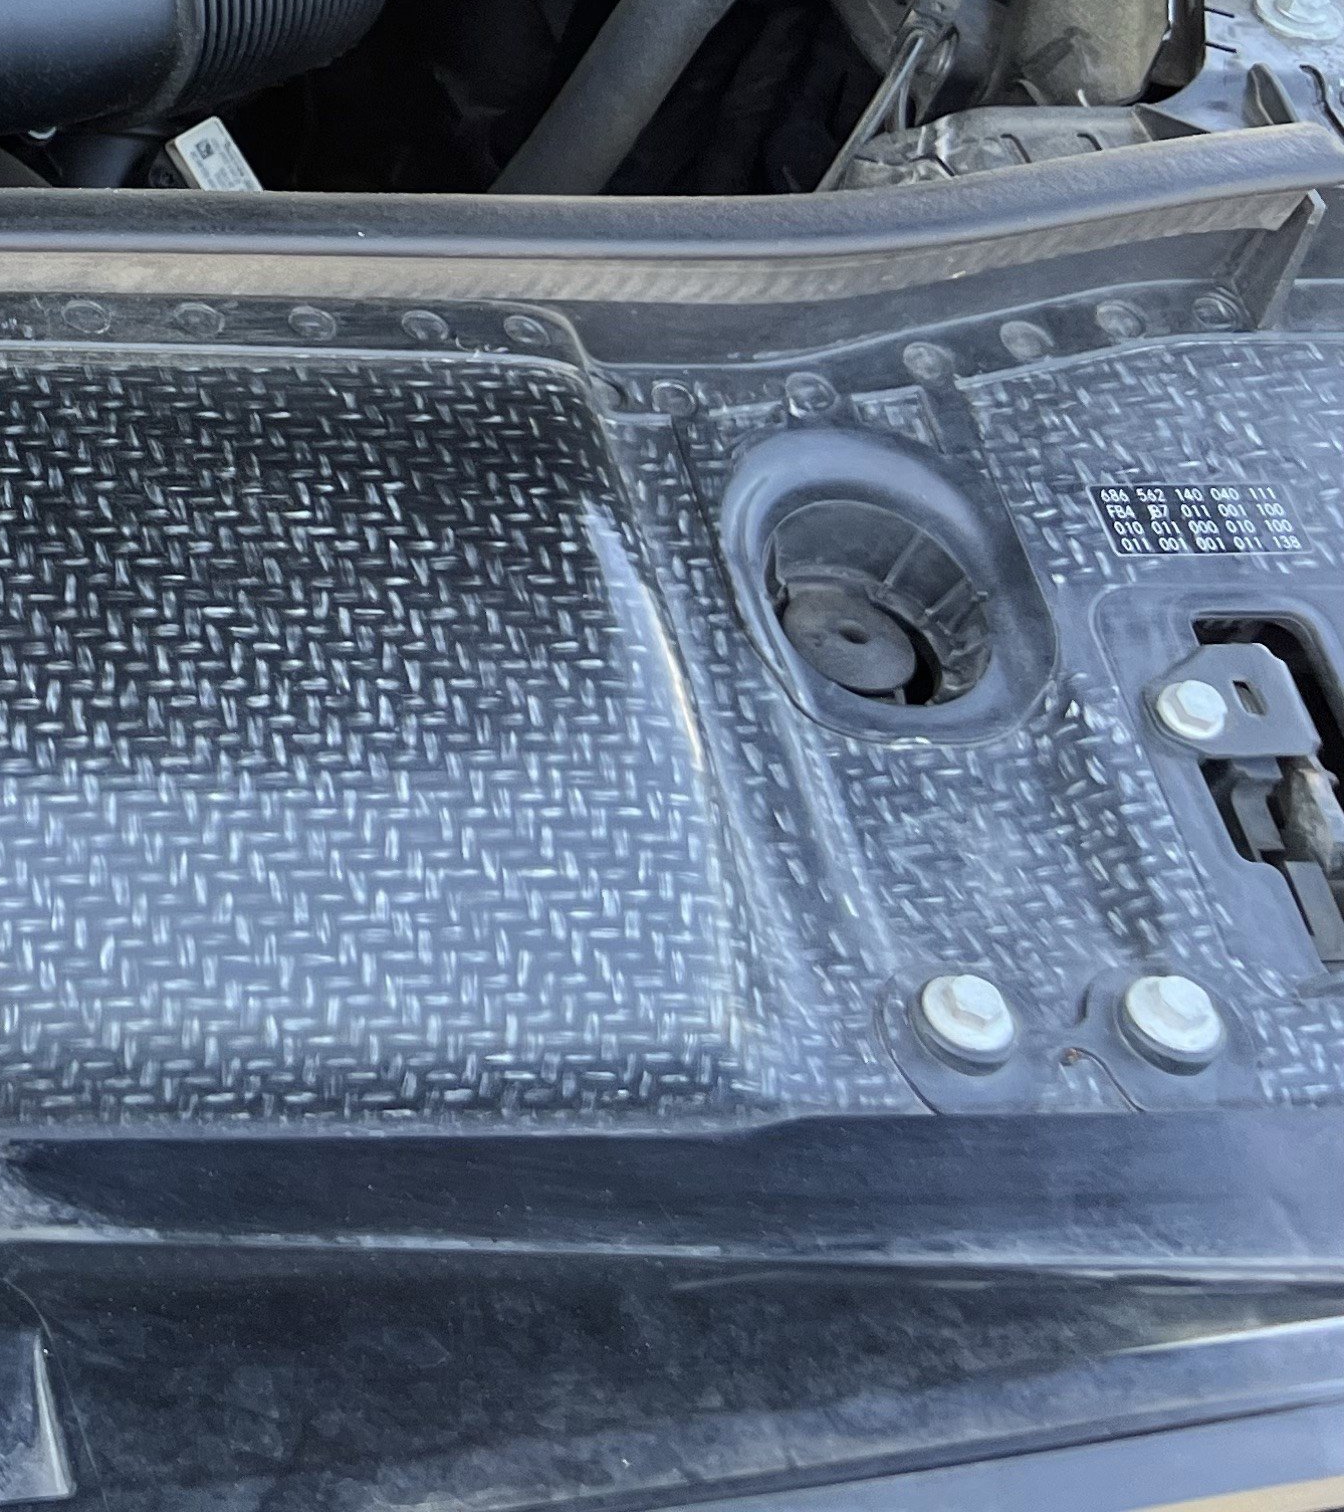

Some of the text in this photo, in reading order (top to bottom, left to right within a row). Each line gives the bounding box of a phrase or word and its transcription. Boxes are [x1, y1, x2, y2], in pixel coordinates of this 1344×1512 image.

[1100, 487, 1277, 503] 686 562 140 040 111
[1181, 504, 1211, 518] 011
[1217, 503, 1247, 517] 001
[1255, 503, 1285, 517] 100
[1113, 519, 1293, 535] 010 011 000 010 100
[1121, 535, 1302, 552] 011 001 001 011 138
